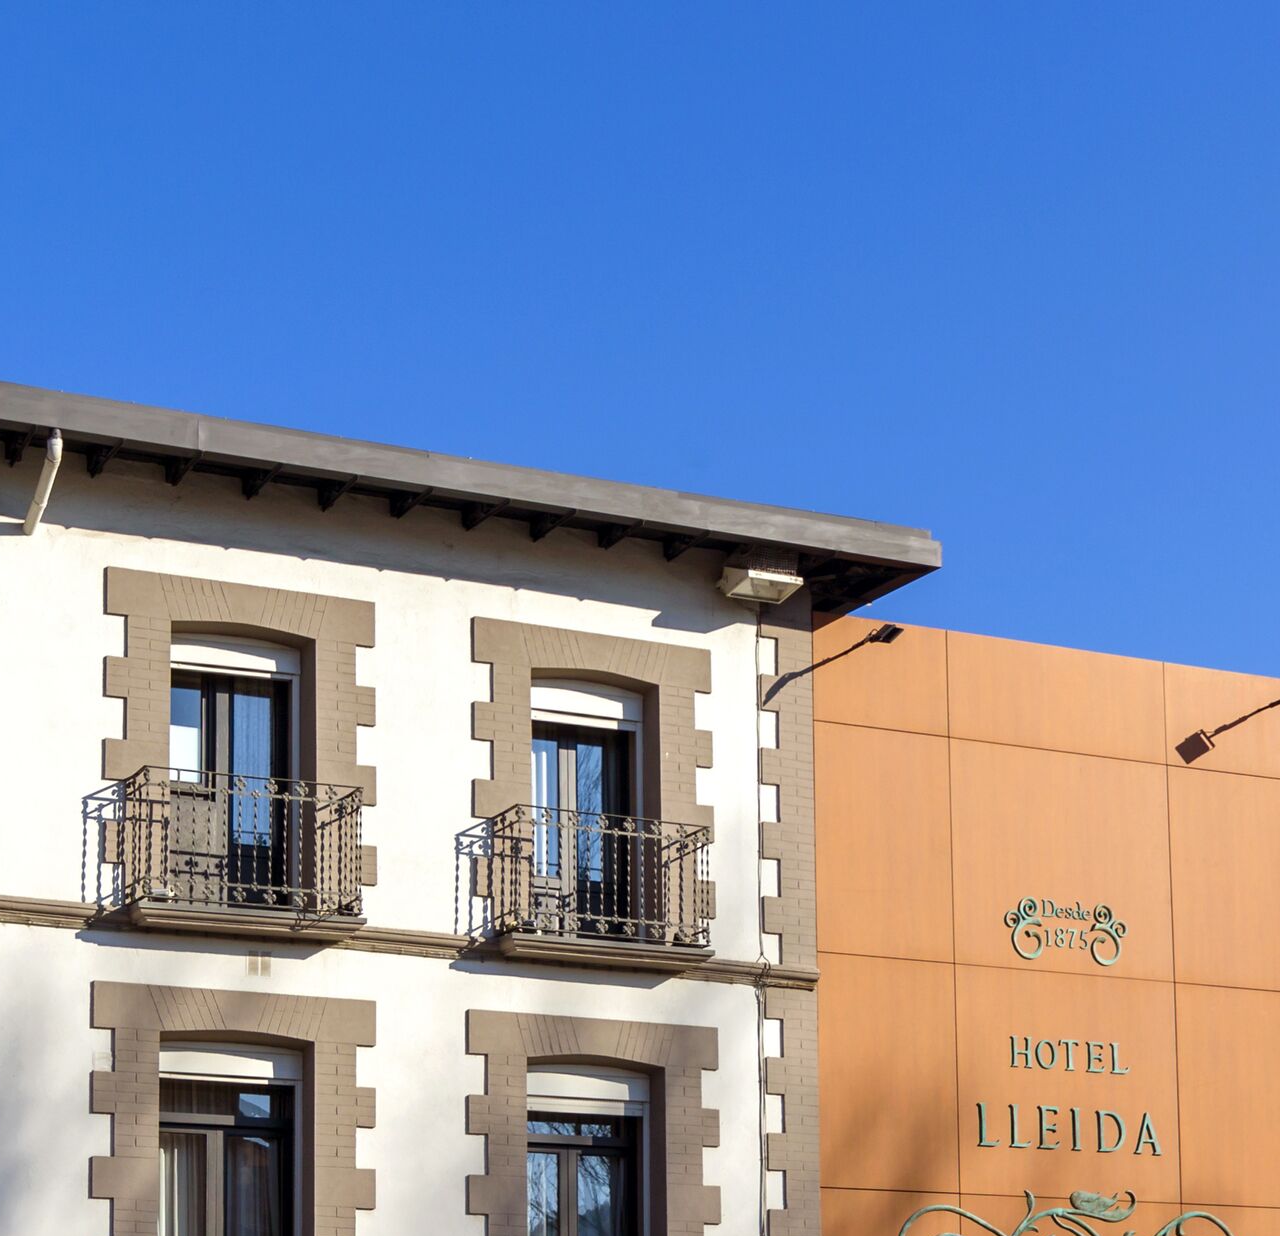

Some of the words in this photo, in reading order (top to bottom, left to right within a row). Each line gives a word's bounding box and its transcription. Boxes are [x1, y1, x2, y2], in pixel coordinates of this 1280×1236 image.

[1041, 899, 1091, 921] Desde
[1044, 928, 1088, 950] 1875
[1009, 1034, 1130, 1076] HOTEL
[975, 1101, 1162, 1156] LLEIDA
